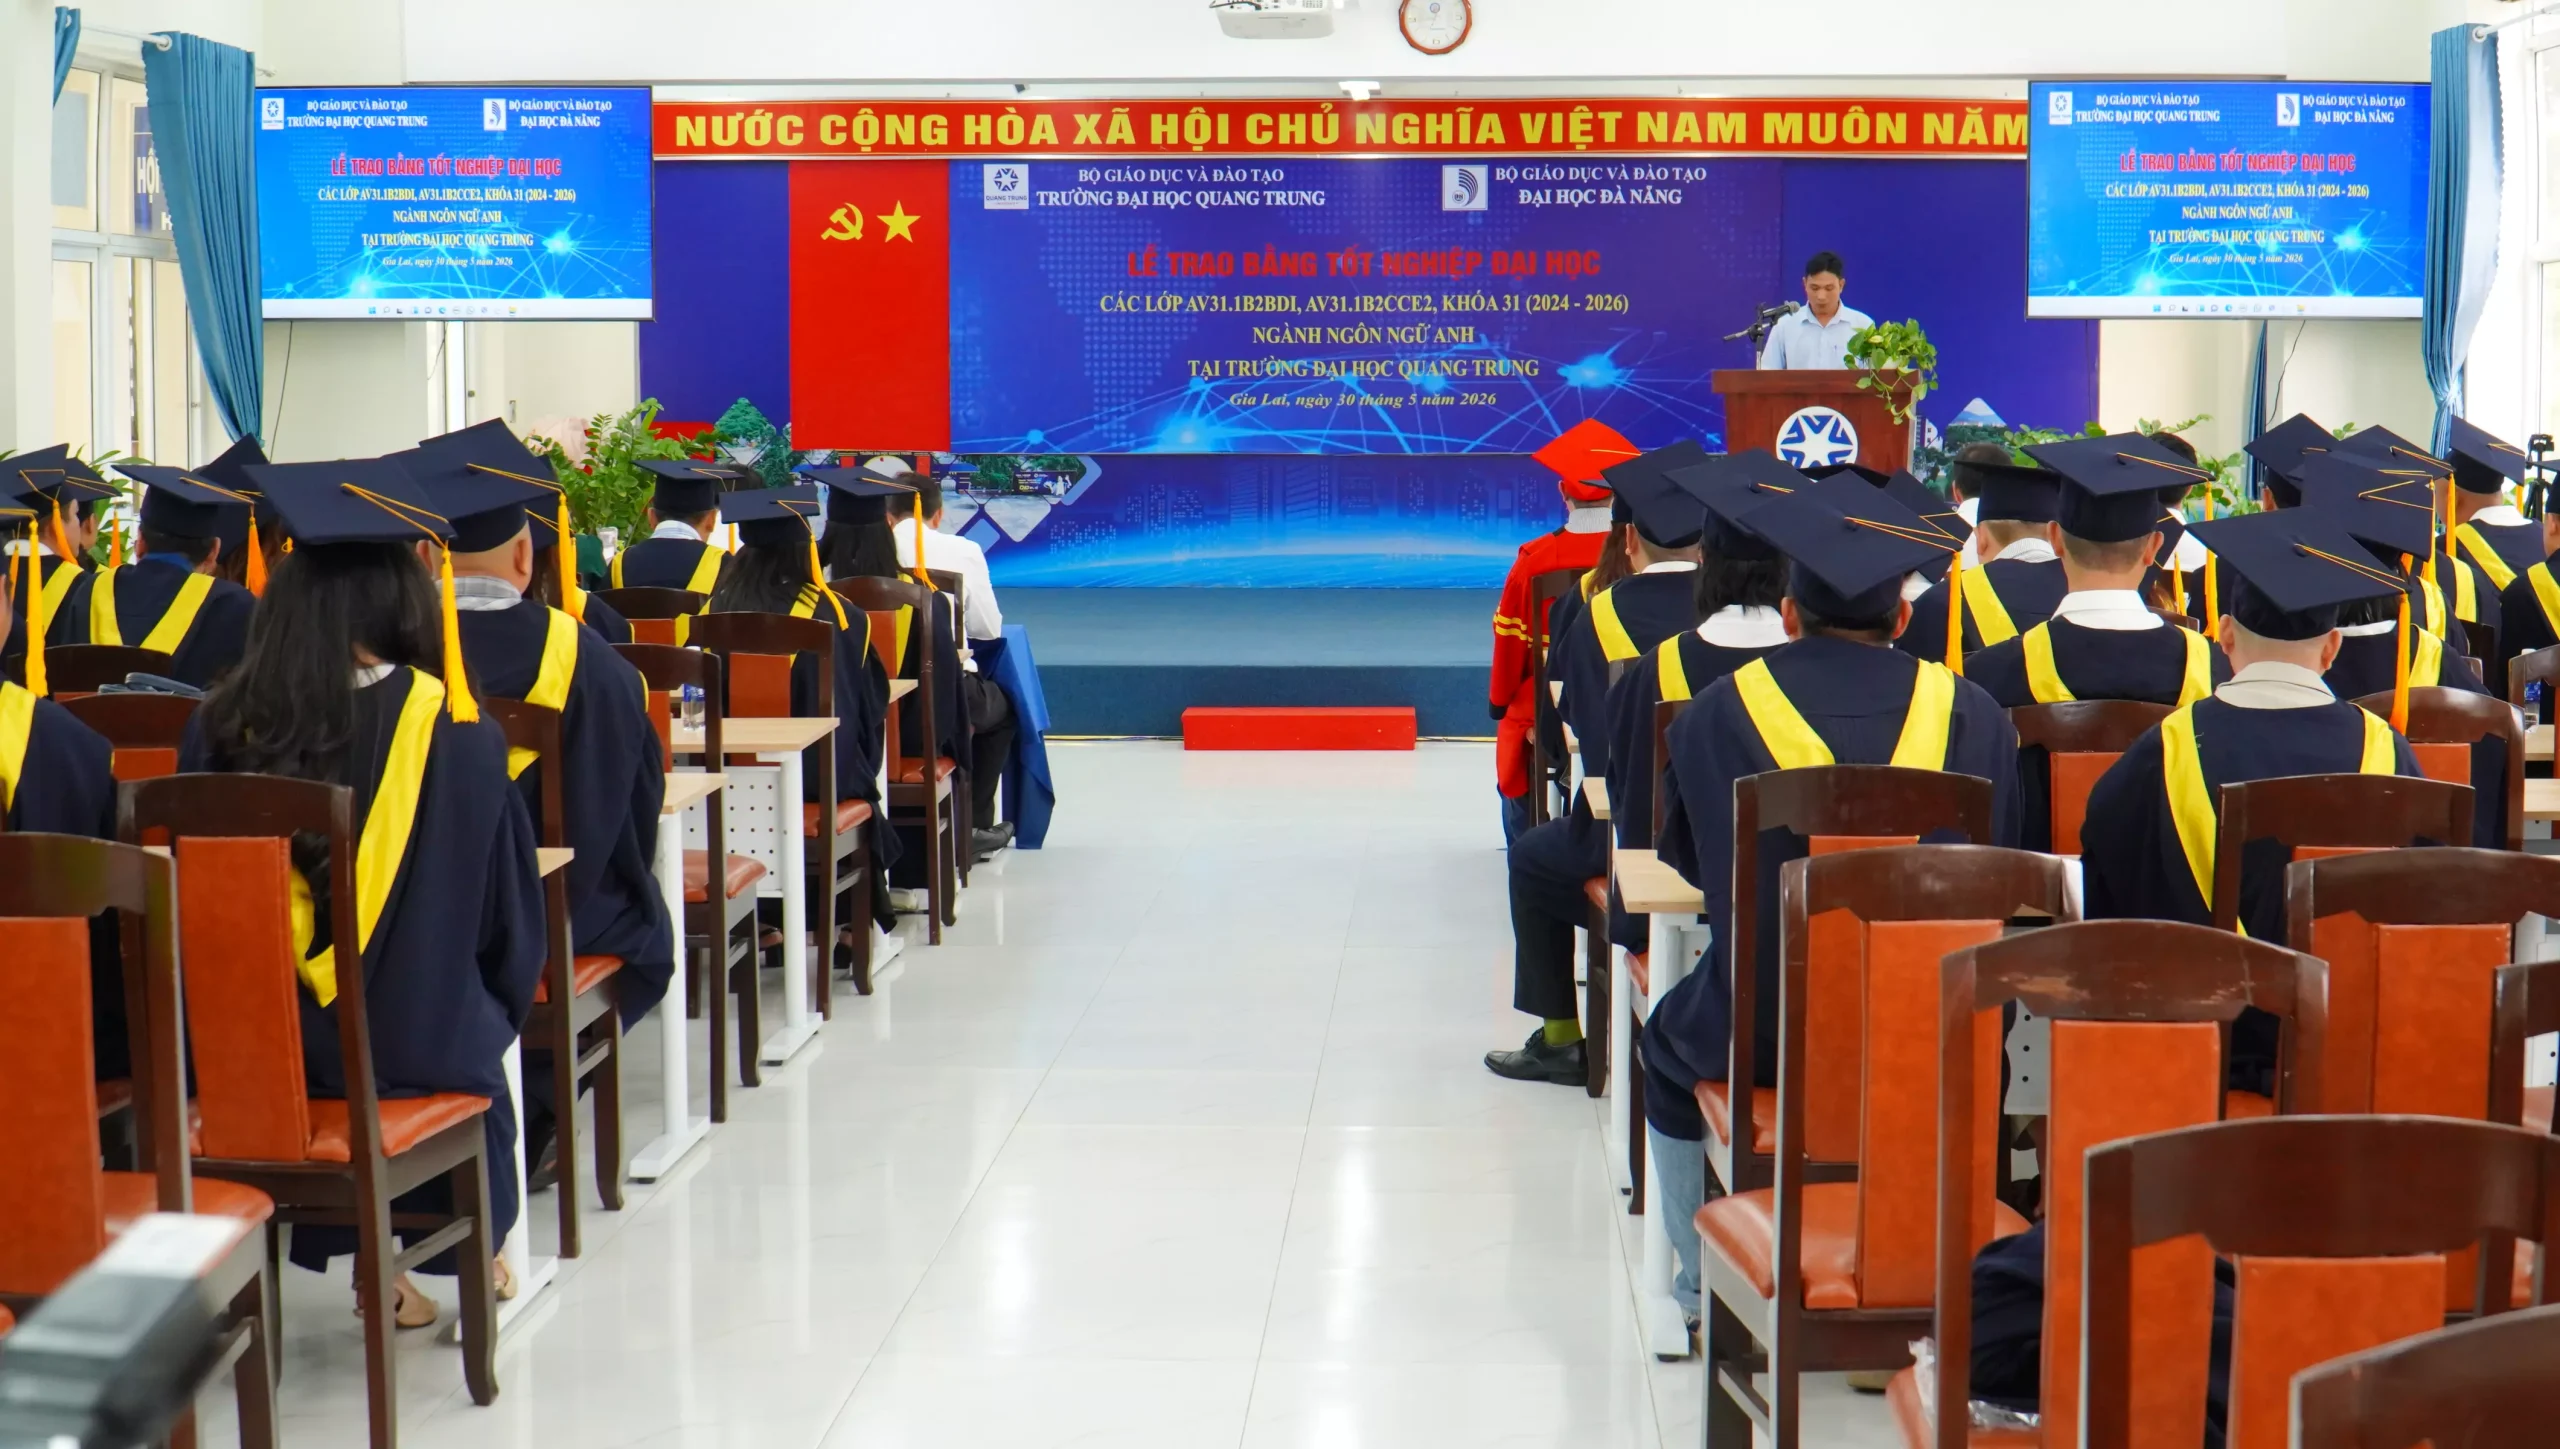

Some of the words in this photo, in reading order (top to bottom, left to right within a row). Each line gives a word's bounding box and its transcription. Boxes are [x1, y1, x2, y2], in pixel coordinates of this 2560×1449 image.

[287, 114, 324, 127] TRƯỜNG
[326, 116, 341, 129] ĐẠI
[343, 116, 362, 129] HỌC
[364, 116, 395, 128] QUANG
[396, 116, 428, 127] TRUNG
[2075, 108, 2114, 122] TRƯỜNG
[2116, 111, 2132, 124] ĐẠI
[2134, 111, 2153, 124] HỌC
[2155, 111, 2187, 123] QUANG
[2189, 111, 2220, 122] TRUNG
[676, 109, 804, 147] NƯỚC
[820, 108, 948, 151] CỘNG
[964, 106, 1059, 146] HÒA
[1072, 107, 1136, 145] XÃ
[1150, 107, 1229, 151] HỘI
[1245, 102, 1340, 145] CHỦ
[1355, 106, 1506, 145] NGHĨA
[1519, 106, 1623, 149] VIỆT
[1637, 112, 1747, 144] NAM
[1763, 106, 1907, 144] MUÔN
[1923, 106, 2028, 146] NĂM
[351, 159, 384, 175] TRAO
[429, 152, 451, 175] TỐT
[456, 155, 504, 180] NGHIỆP
[535, 159, 562, 179] HỌC
[2141, 154, 2174, 171] TRAO
[2220, 147, 2244, 171] TỐT
[2248, 151, 2297, 175] NGHIỆP
[2328, 154, 2355, 175] HỌC
[1078, 167, 1100, 185] BỘ
[1104, 166, 1145, 181] GIÁO
[1150, 169, 1183, 185] DỤC
[1187, 166, 1208, 181] VÀ
[1212, 165, 1247, 181] ĐÀO
[1251, 169, 1284, 184] TẠO
[1495, 166, 1518, 184] BỘ
[1522, 164, 1564, 180] GIÁO
[1569, 168, 1603, 183] DỤC
[1606, 164, 1629, 180] VÀ
[1633, 164, 1668, 180] ĐÀO
[1672, 168, 1706, 183] TẠO
[514, 189, 523, 200] 31
[525, 189, 547, 202] (2024
[554, 189, 576, 202] 2026)
[1036, 187, 1113, 206] TRƯỜNG
[1116, 191, 1149, 209] ĐẠI
[1152, 191, 1192, 209] HỌC
[1195, 191, 1260, 209] QUANG
[1263, 191, 1325, 206] TRUNG
[1519, 190, 1552, 207] ĐẠI
[1556, 190, 1596, 207] HỌC
[1600, 186, 1626, 204] ĐÀ
[2307, 184, 2315, 197] 31
[2318, 184, 2340, 198] (2024
[2347, 184, 2369, 199] 2026)
[481, 211, 501, 222] ANH
[2272, 206, 2293, 218] ANH
[1168, 252, 1234, 277] TRAO
[1326, 244, 1374, 277] TỐT
[1382, 246, 1483, 281] NGHIỆP
[1492, 251, 1536, 280] ĐẠI
[1546, 251, 1600, 280] HỌC
[1100, 291, 1140, 312] CÁC
[1145, 291, 1183, 312] LỚP
[1186, 295, 1302, 314] AV31.1B2BDI,
[1306, 295, 1437, 314] AV31.1B2CCE2,
[1442, 290, 1498, 311] KHÓA
[1502, 295, 1521, 311] 31
[1526, 294, 1570, 314] (2024
[1585, 294, 1629, 314] 2026)
[1253, 323, 1321, 344] NGÀNH
[1327, 323, 1381, 344] NGÔN
[1388, 322, 1430, 343] NGỮ
[1434, 327, 1475, 343] ANH
[1188, 360, 1220, 381] TẠI
[1226, 356, 1308, 377] TRƯỜNG
[1313, 360, 1347, 381] ĐẠI
[1352, 360, 1393, 381] HỌC
[1399, 360, 1467, 380] QUANG
[1472, 360, 1539, 376] TRUNG
[1230, 393, 1256, 406] Gia
[1262, 394, 1291, 407] Lai,
[1295, 394, 1332, 409] ngày
[1337, 394, 1355, 406] 30
[1359, 394, 1403, 408] tháng
[1408, 393, 1417, 406] 5
[1422, 393, 1455, 406] năm
[1460, 393, 1496, 405] 2026
